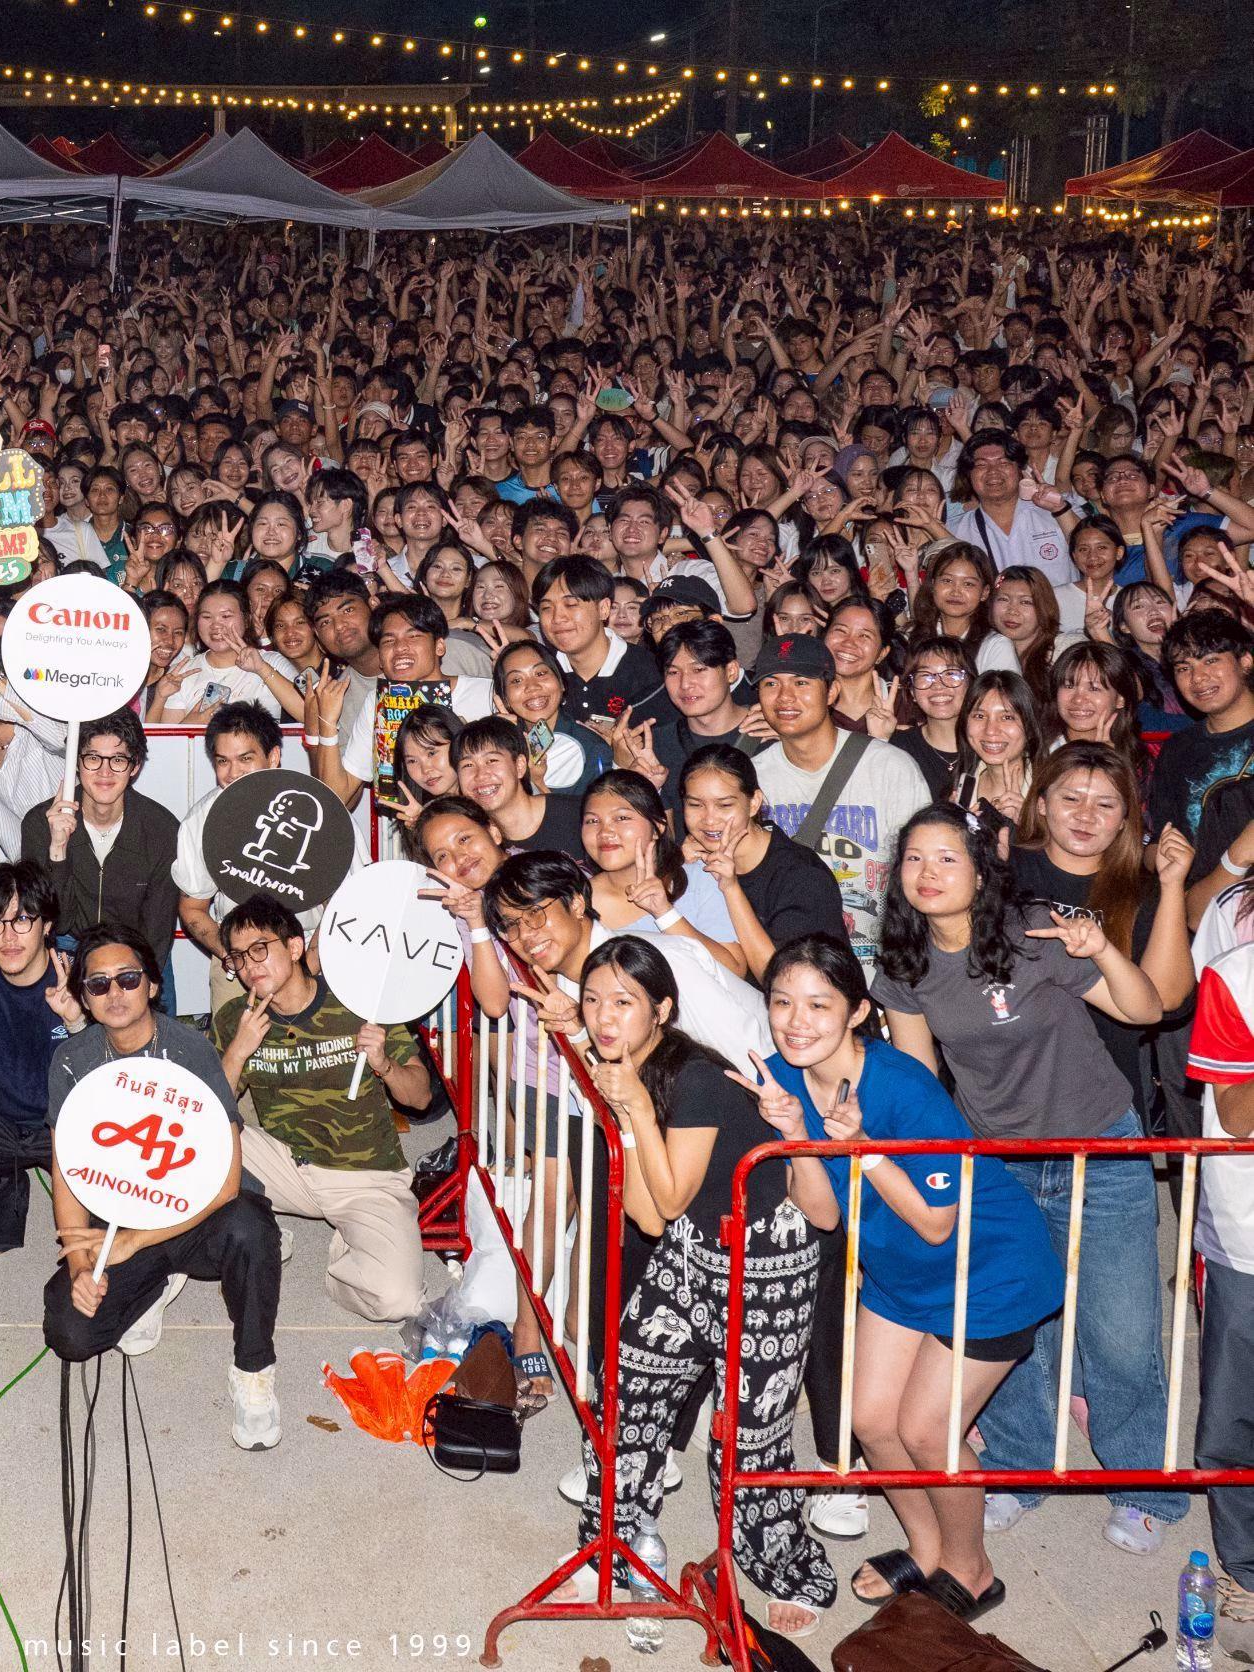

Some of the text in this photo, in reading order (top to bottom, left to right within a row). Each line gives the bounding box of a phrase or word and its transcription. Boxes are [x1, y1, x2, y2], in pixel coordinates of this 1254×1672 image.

[28, 602, 131, 631] Canon
[25, 632, 129, 649] Delighting You Always
[45, 668, 125, 688] MegaTank
[386, 708, 410, 721] ROO
[219, 859, 305, 901] Smallroom
[328, 911, 459, 971] KAVE
[316, 1036, 354, 1055] HIDING
[248, 1049, 358, 1075] FROM MY PARENTS
[115, 1071, 204, 1114] กินดี มีสุข
[66, 1167, 190, 1213] AJINOMOTO
[522, 1357, 546, 1368] POLO
[523, 1364, 548, 1374] 1982
